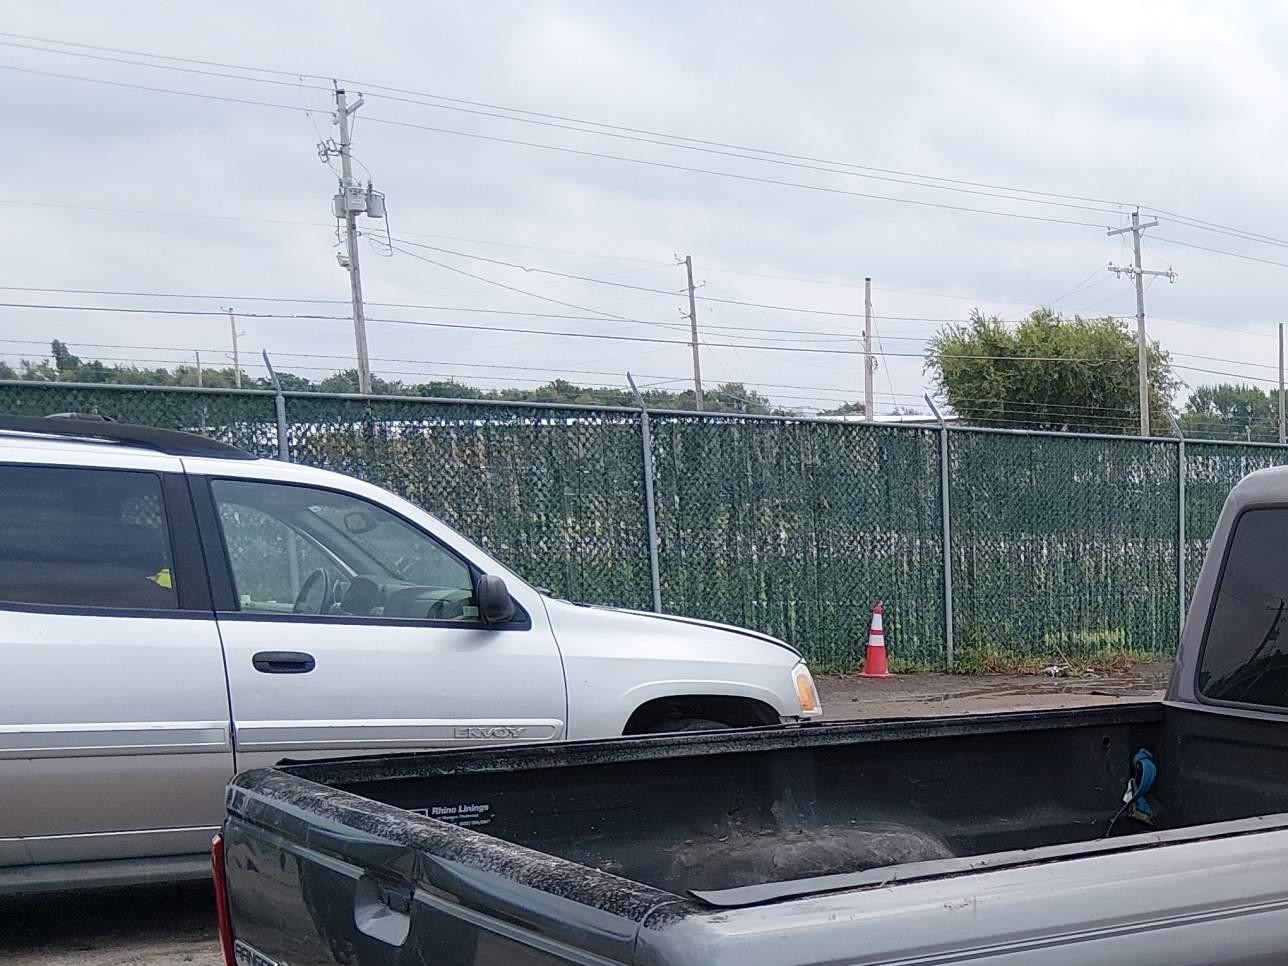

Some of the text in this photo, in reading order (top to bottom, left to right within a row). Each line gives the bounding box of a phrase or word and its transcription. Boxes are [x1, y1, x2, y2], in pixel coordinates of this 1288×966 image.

[453, 726, 524, 739] ENVOY
[431, 803, 489, 816] Rhino Linings
